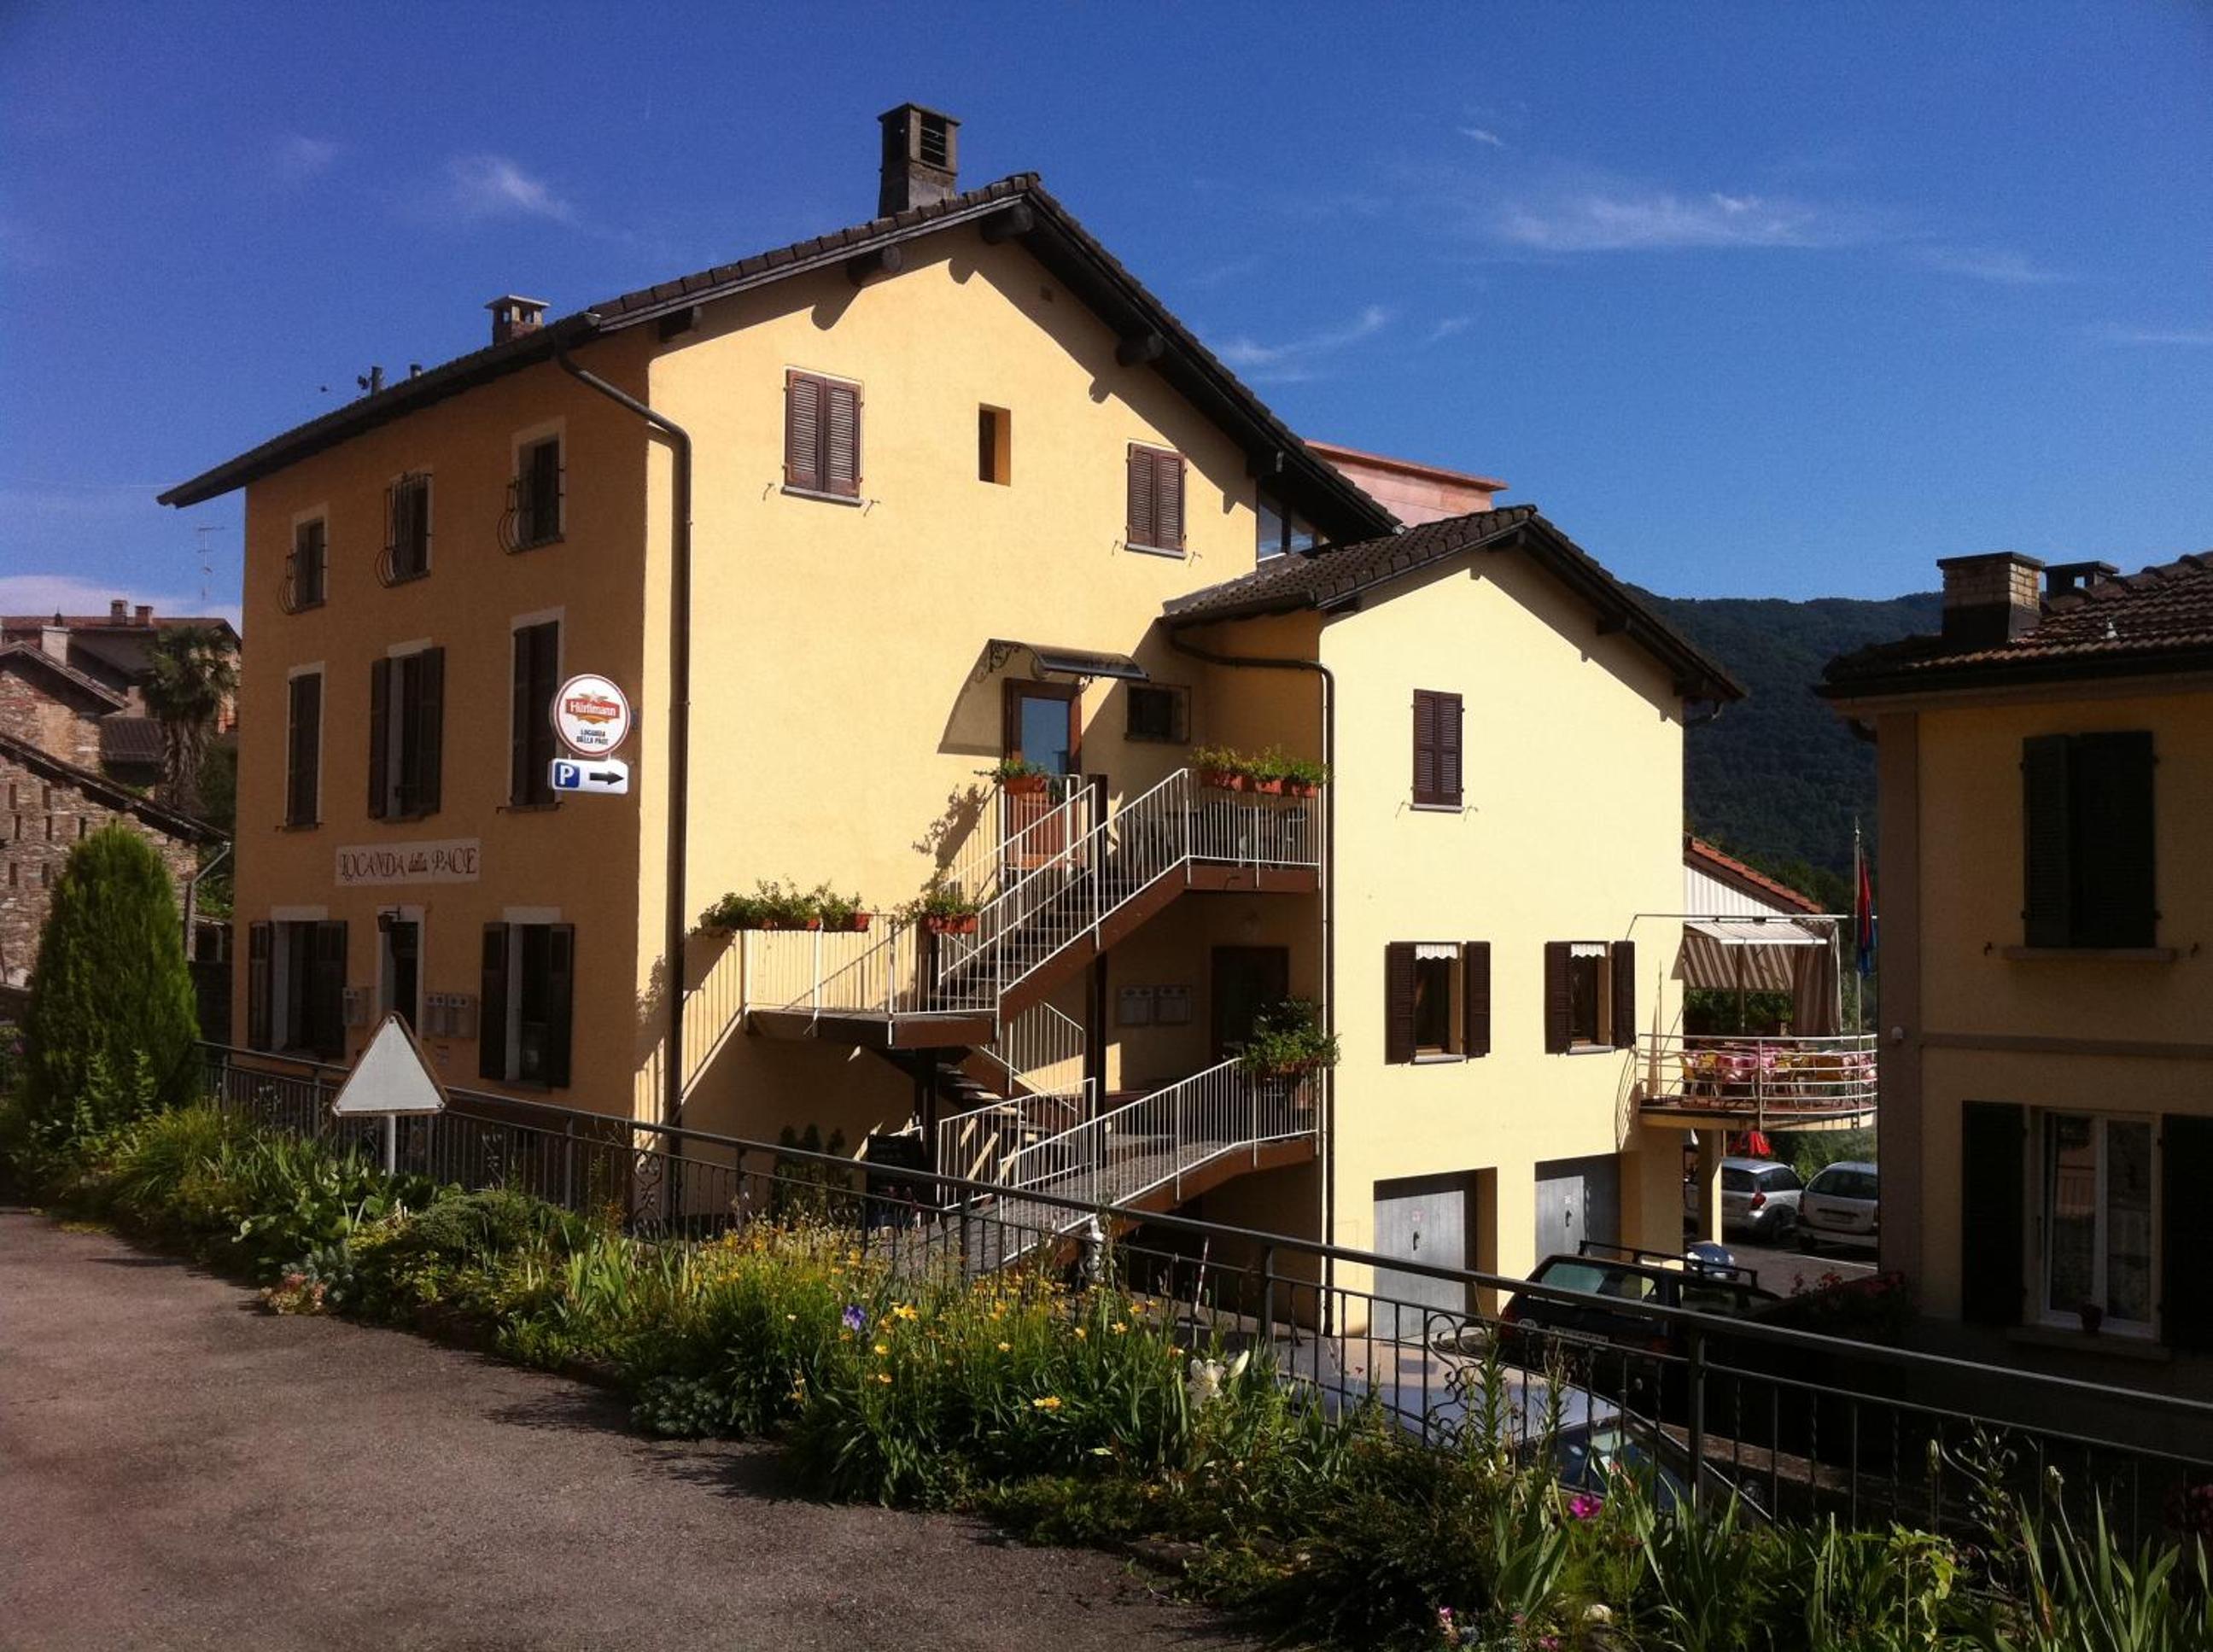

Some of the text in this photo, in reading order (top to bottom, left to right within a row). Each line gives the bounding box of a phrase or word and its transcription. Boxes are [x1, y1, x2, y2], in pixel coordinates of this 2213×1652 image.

[559, 764, 575, 785] P
[342, 851, 406, 880] LOCANDA
[431, 847, 476, 876] PACE
